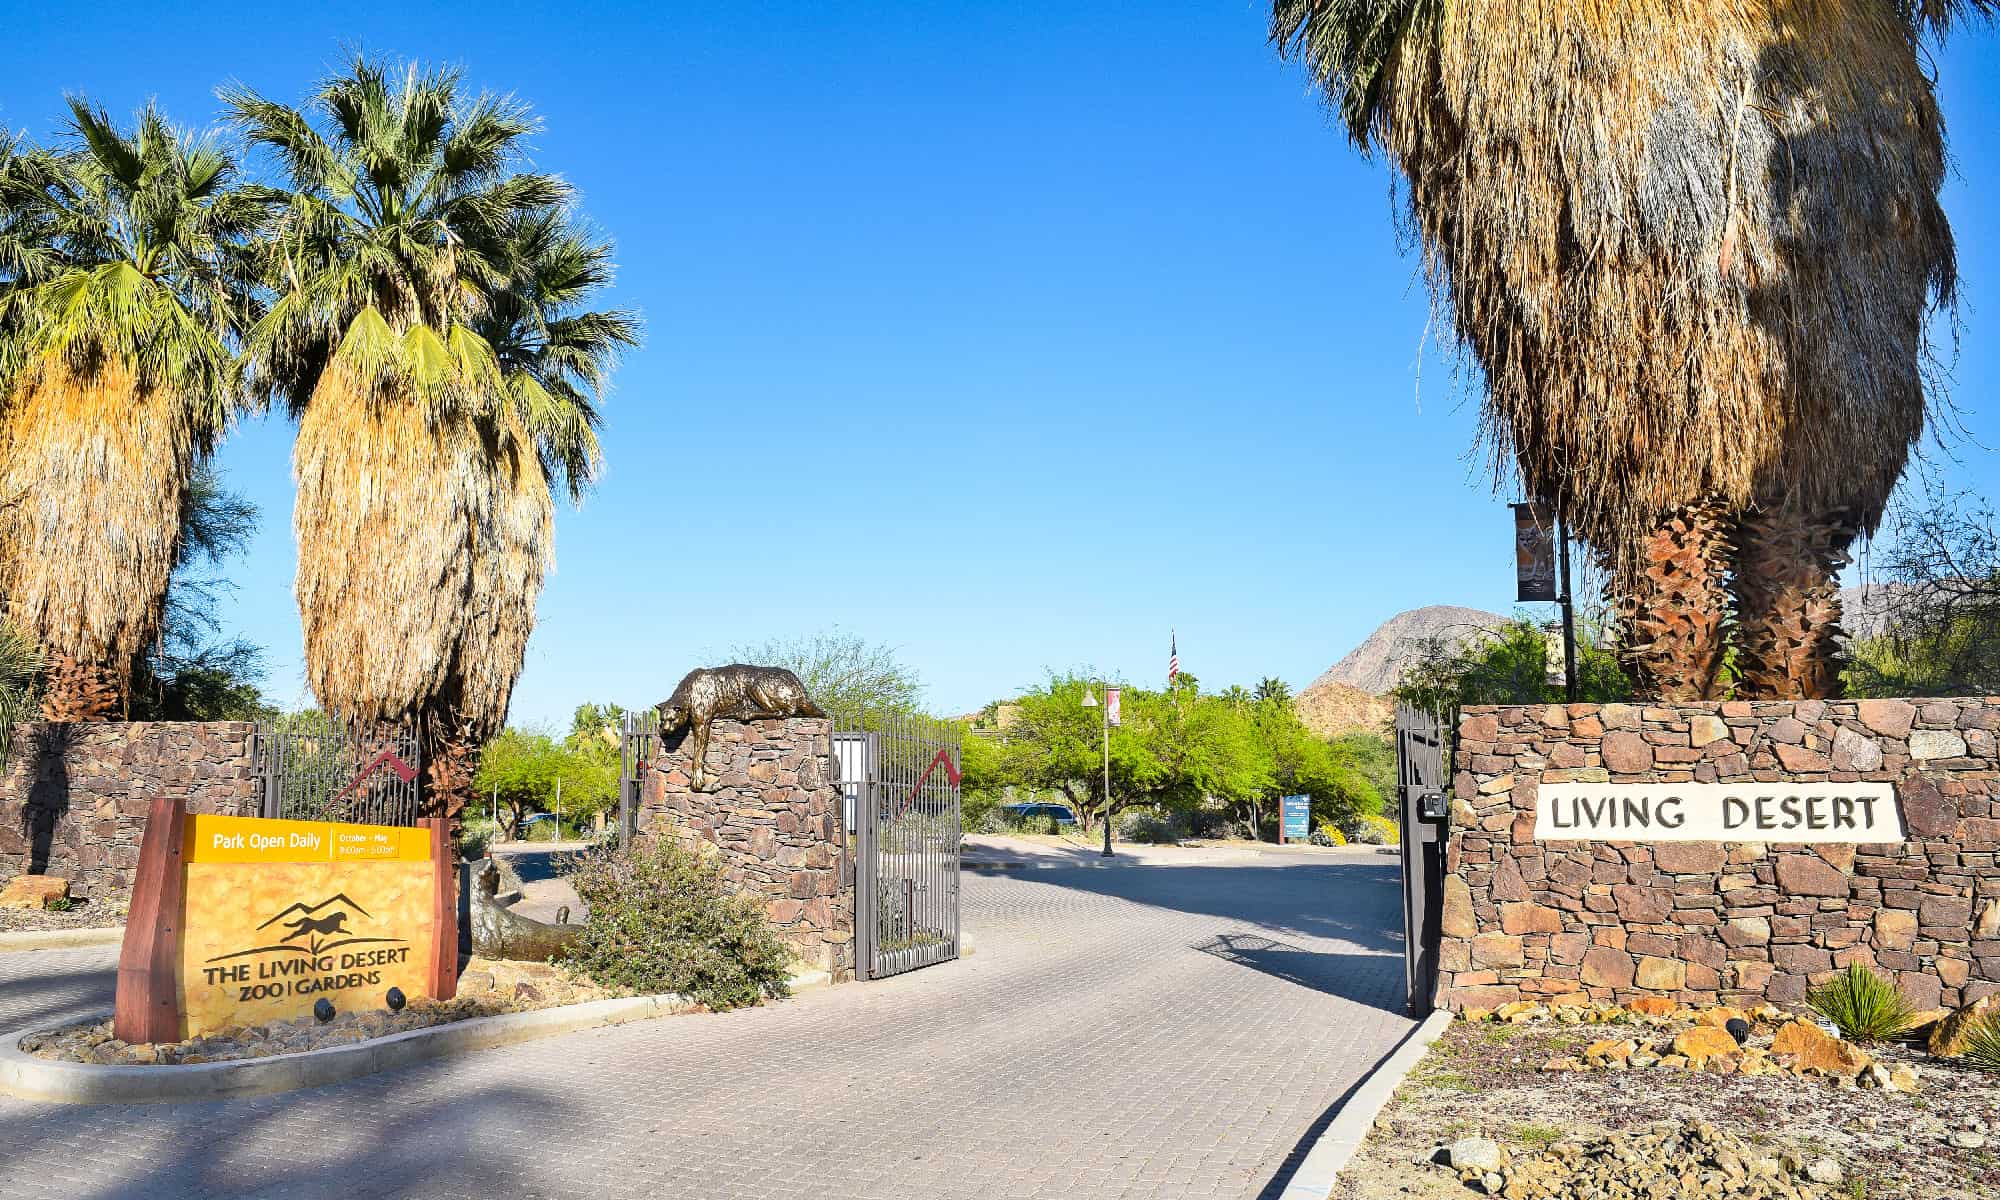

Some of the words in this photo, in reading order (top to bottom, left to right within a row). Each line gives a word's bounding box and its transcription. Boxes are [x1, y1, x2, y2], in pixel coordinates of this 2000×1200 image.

[1551, 796, 1686, 829] LIVING
[1722, 796, 1880, 829] DESERT
[213, 833, 245, 849] Park
[249, 833, 285, 853] Open
[289, 832, 321, 852] Daily
[203, 964, 250, 985] THE
[259, 956, 333, 979] LIVING
[341, 947, 410, 969] DESERT
[239, 982, 284, 1002] ZOO
[294, 971, 381, 995] GARDENS
